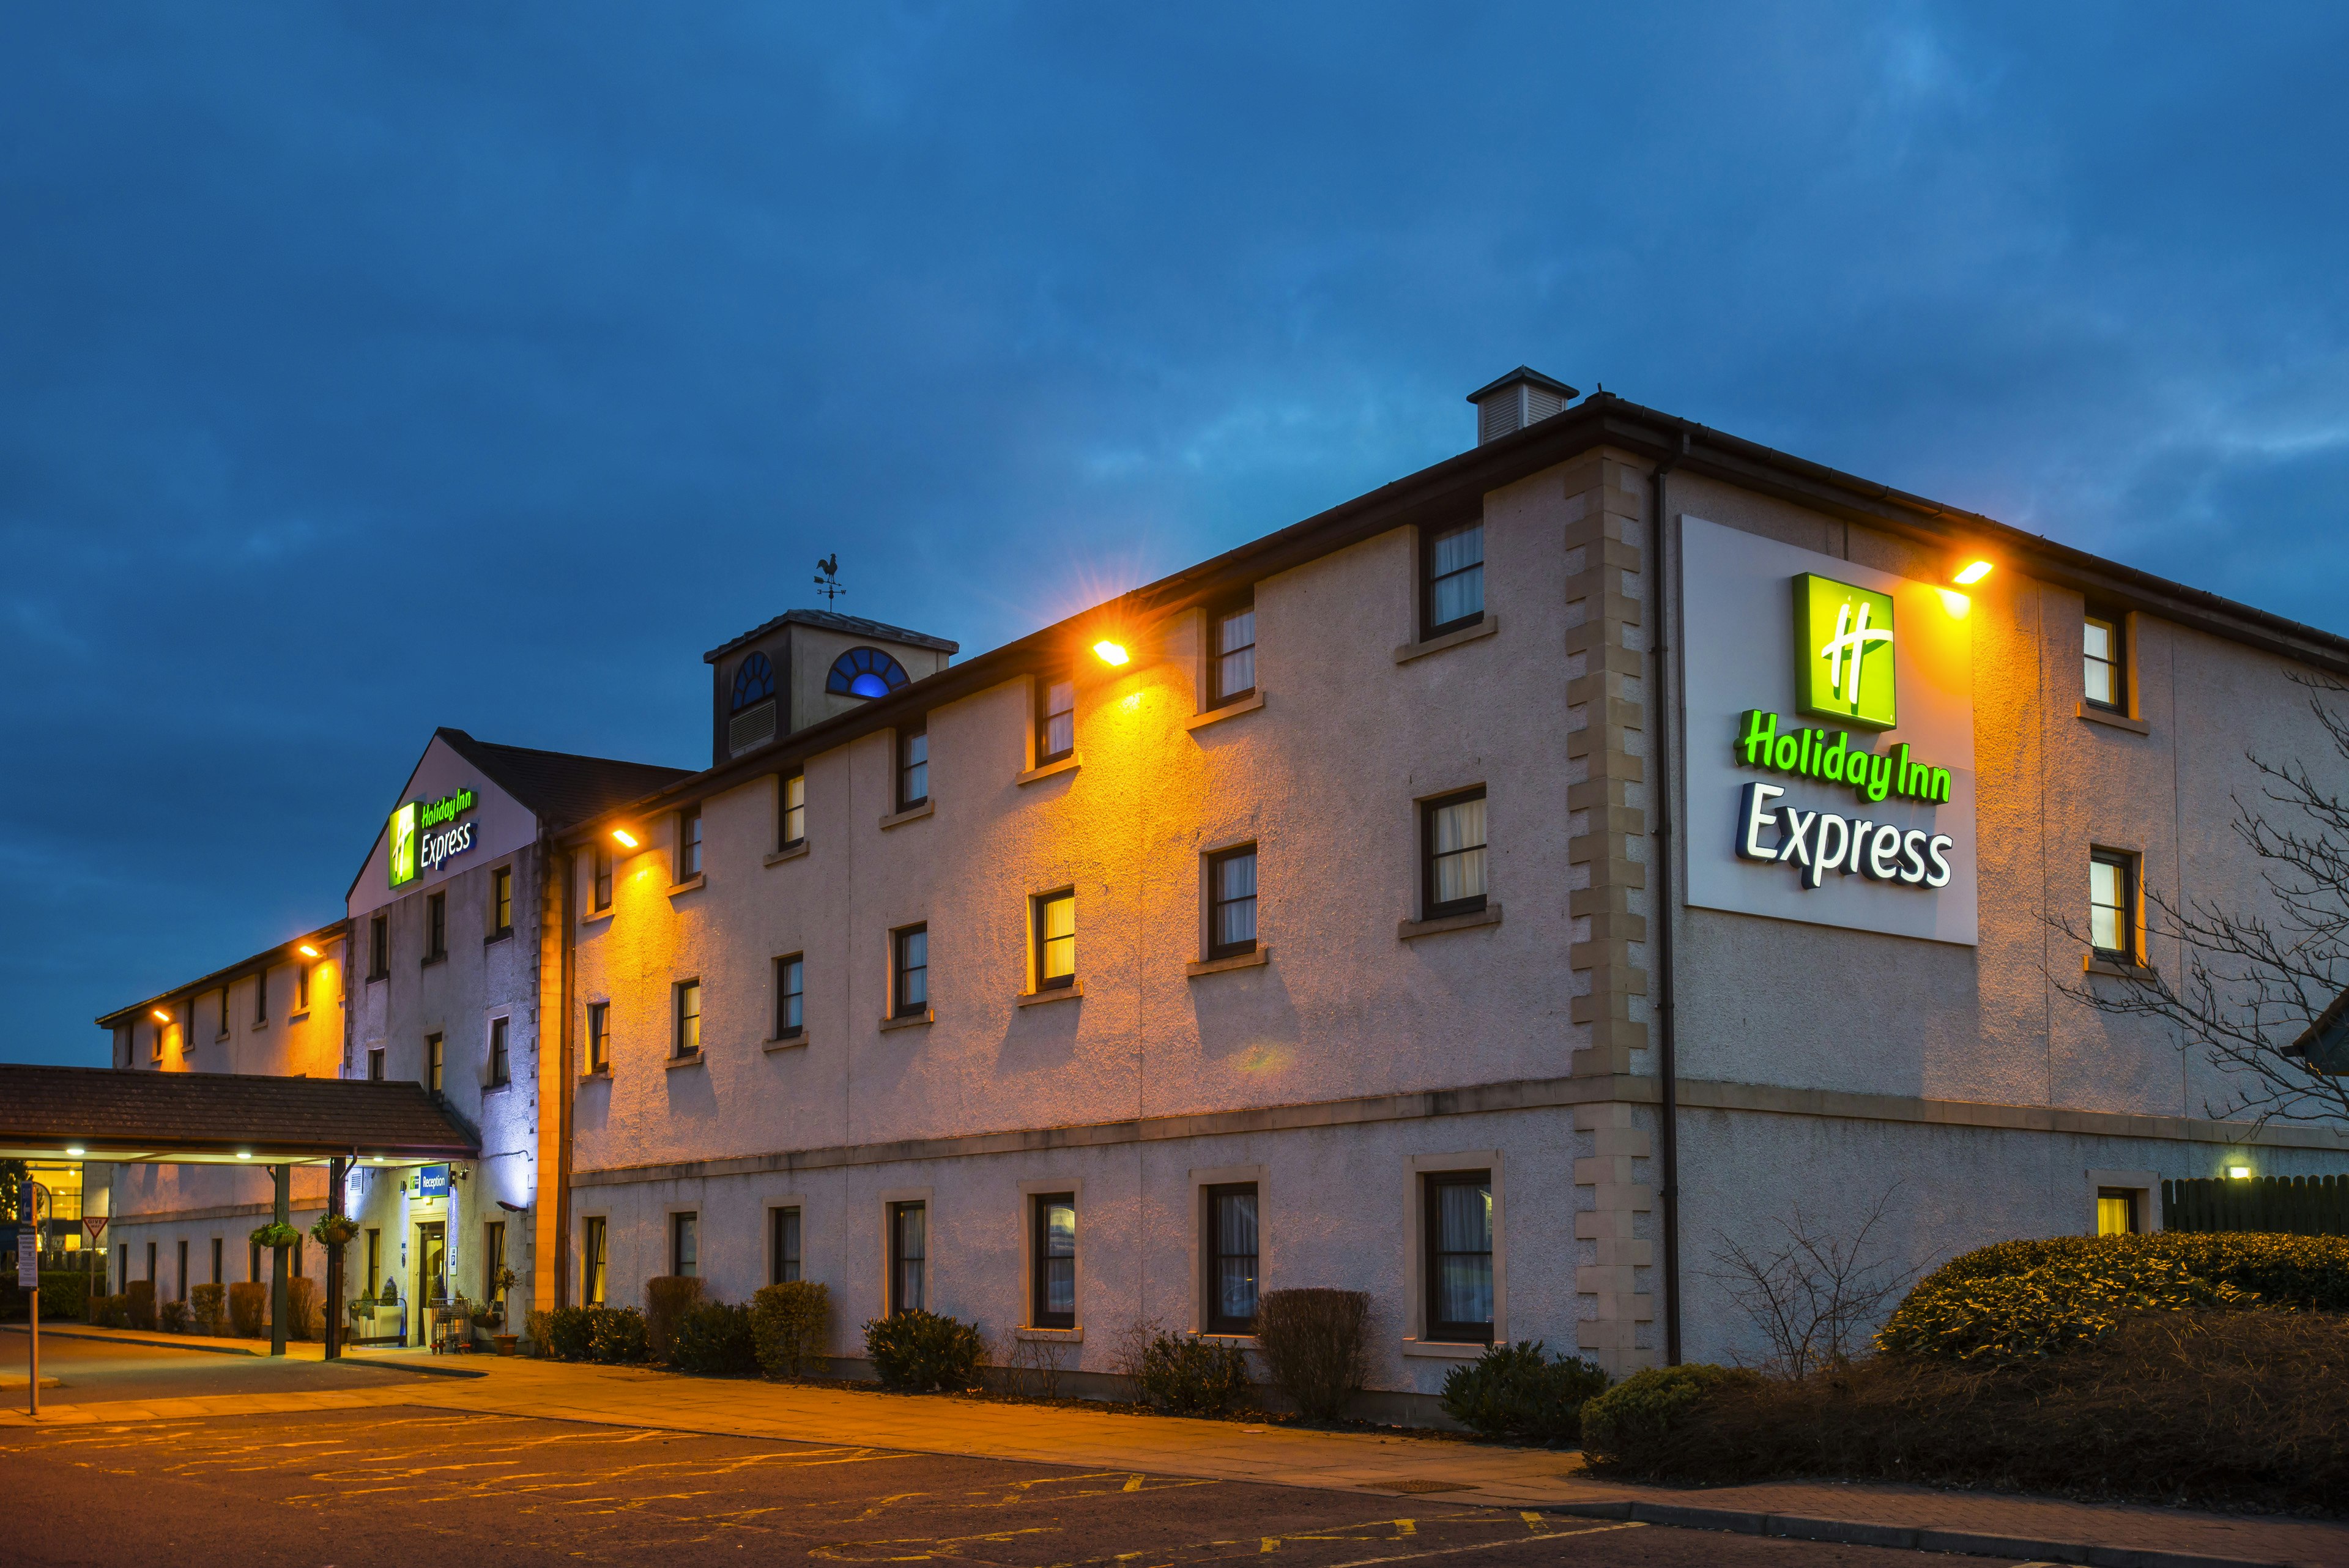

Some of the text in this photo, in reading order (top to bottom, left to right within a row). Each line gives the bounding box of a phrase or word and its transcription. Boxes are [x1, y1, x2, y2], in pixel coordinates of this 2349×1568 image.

[1744, 710, 1951, 803] Holiday Inn
[421, 787, 472, 829] Holiday Inn
[421, 822, 471, 871] Express
[1746, 782, 1954, 888] Express
[423, 1175, 445, 1190] Reception
